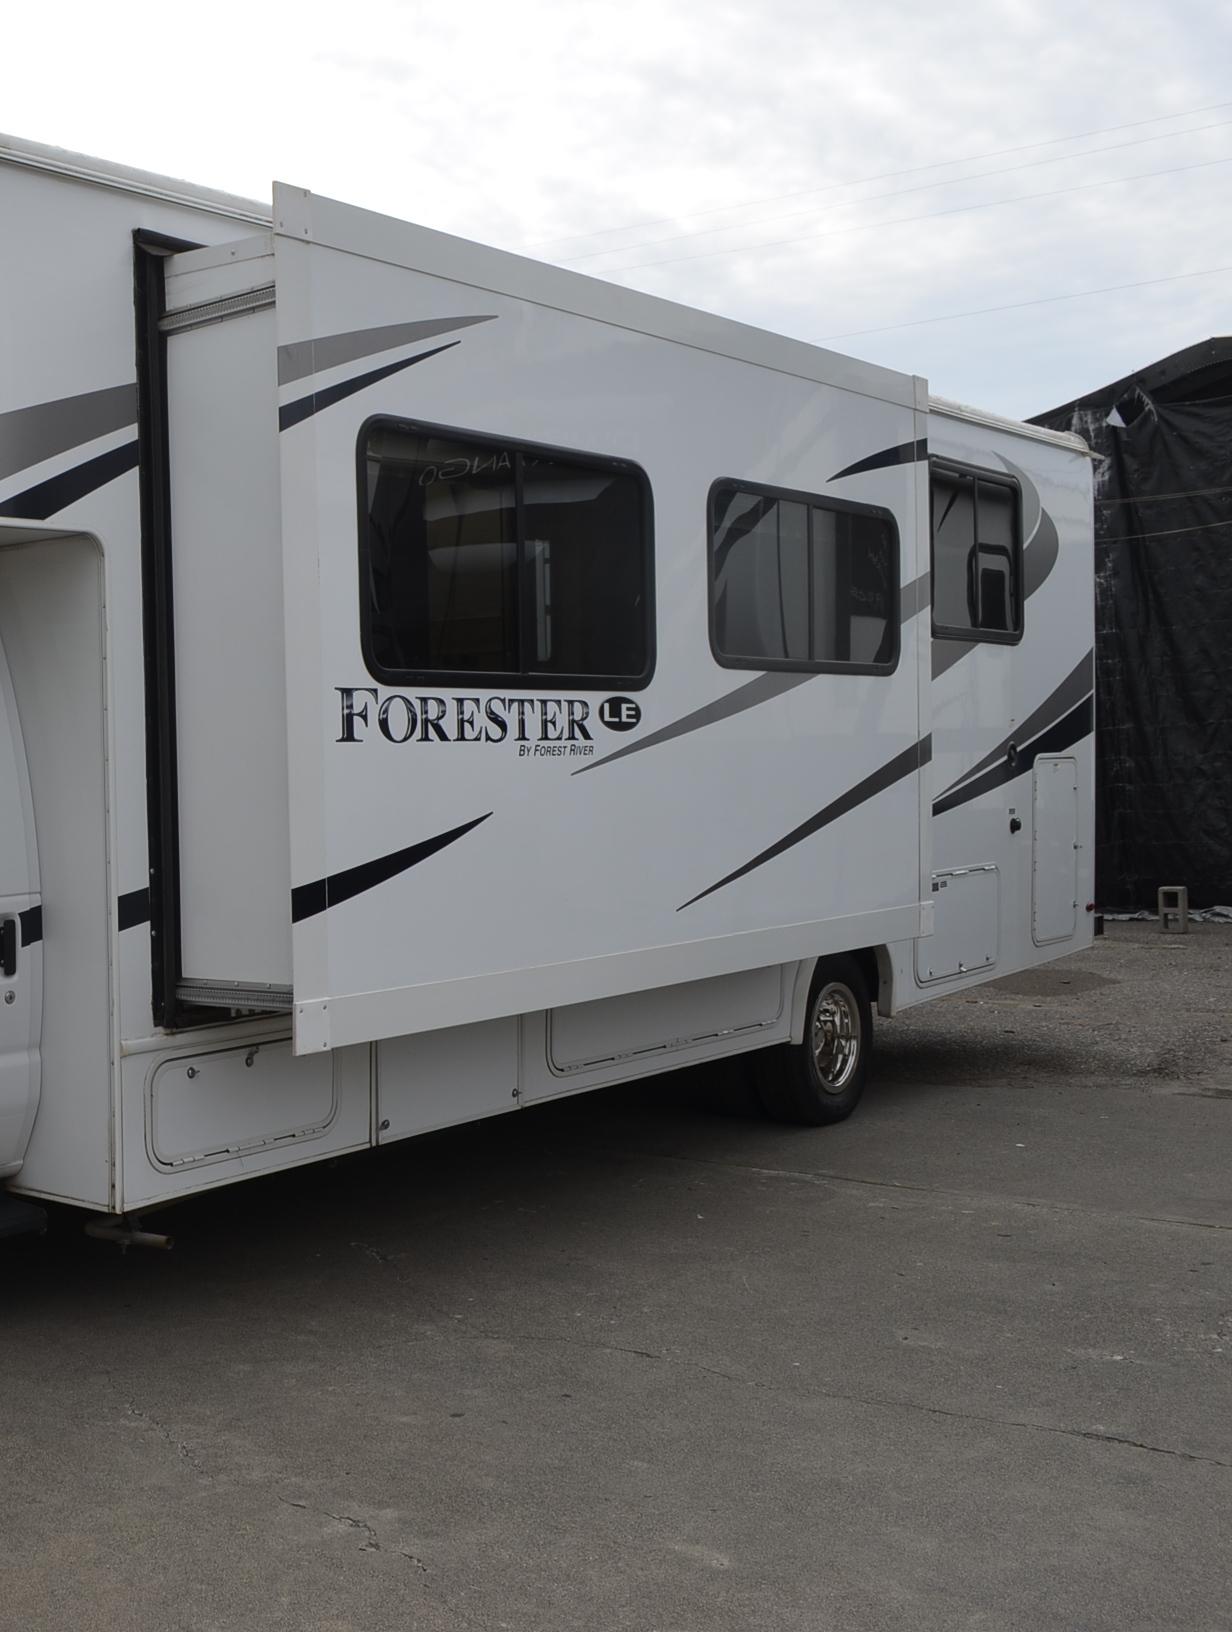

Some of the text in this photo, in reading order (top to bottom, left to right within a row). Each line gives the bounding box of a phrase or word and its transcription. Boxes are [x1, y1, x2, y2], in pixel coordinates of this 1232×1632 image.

[334, 686, 638, 744] FORESTER LE
[518, 744, 594, 757] BY FOREST RIVER
